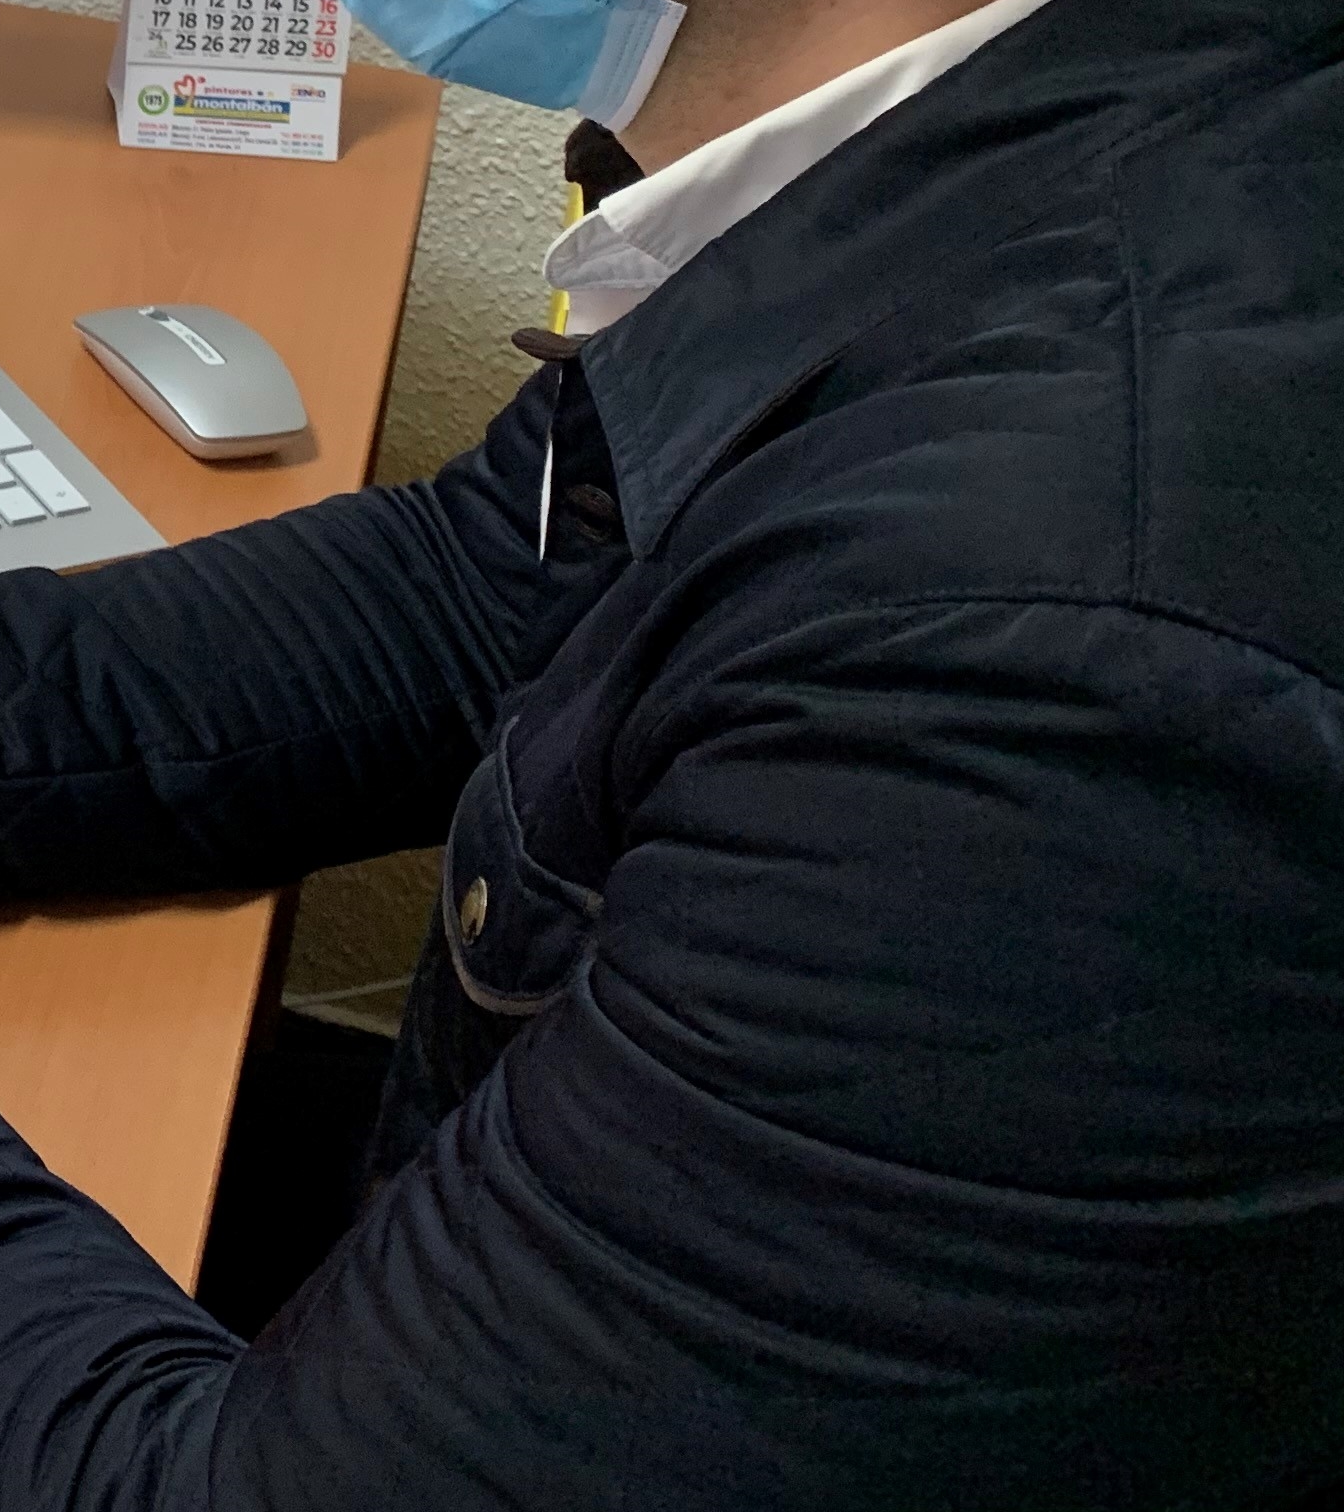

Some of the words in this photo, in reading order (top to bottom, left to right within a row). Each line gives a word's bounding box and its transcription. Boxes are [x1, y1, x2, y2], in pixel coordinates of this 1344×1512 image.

[152, 10, 171, 27] 17
[178, 11, 197, 29] 18
[206, 13, 224, 30] 19
[230, 15, 254, 32] 20
[261, 17, 279, 33] 21
[288, 18, 309, 35] 22
[315, 19, 337, 36] 23
[175, 34, 197, 51] 25
[201, 35, 224, 52] 26
[229, 37, 252, 54] 27
[257, 38, 280, 56] 28
[284, 40, 307, 57] 29
[311, 41, 336, 58] 30
[194, 97, 283, 114] montalbán
